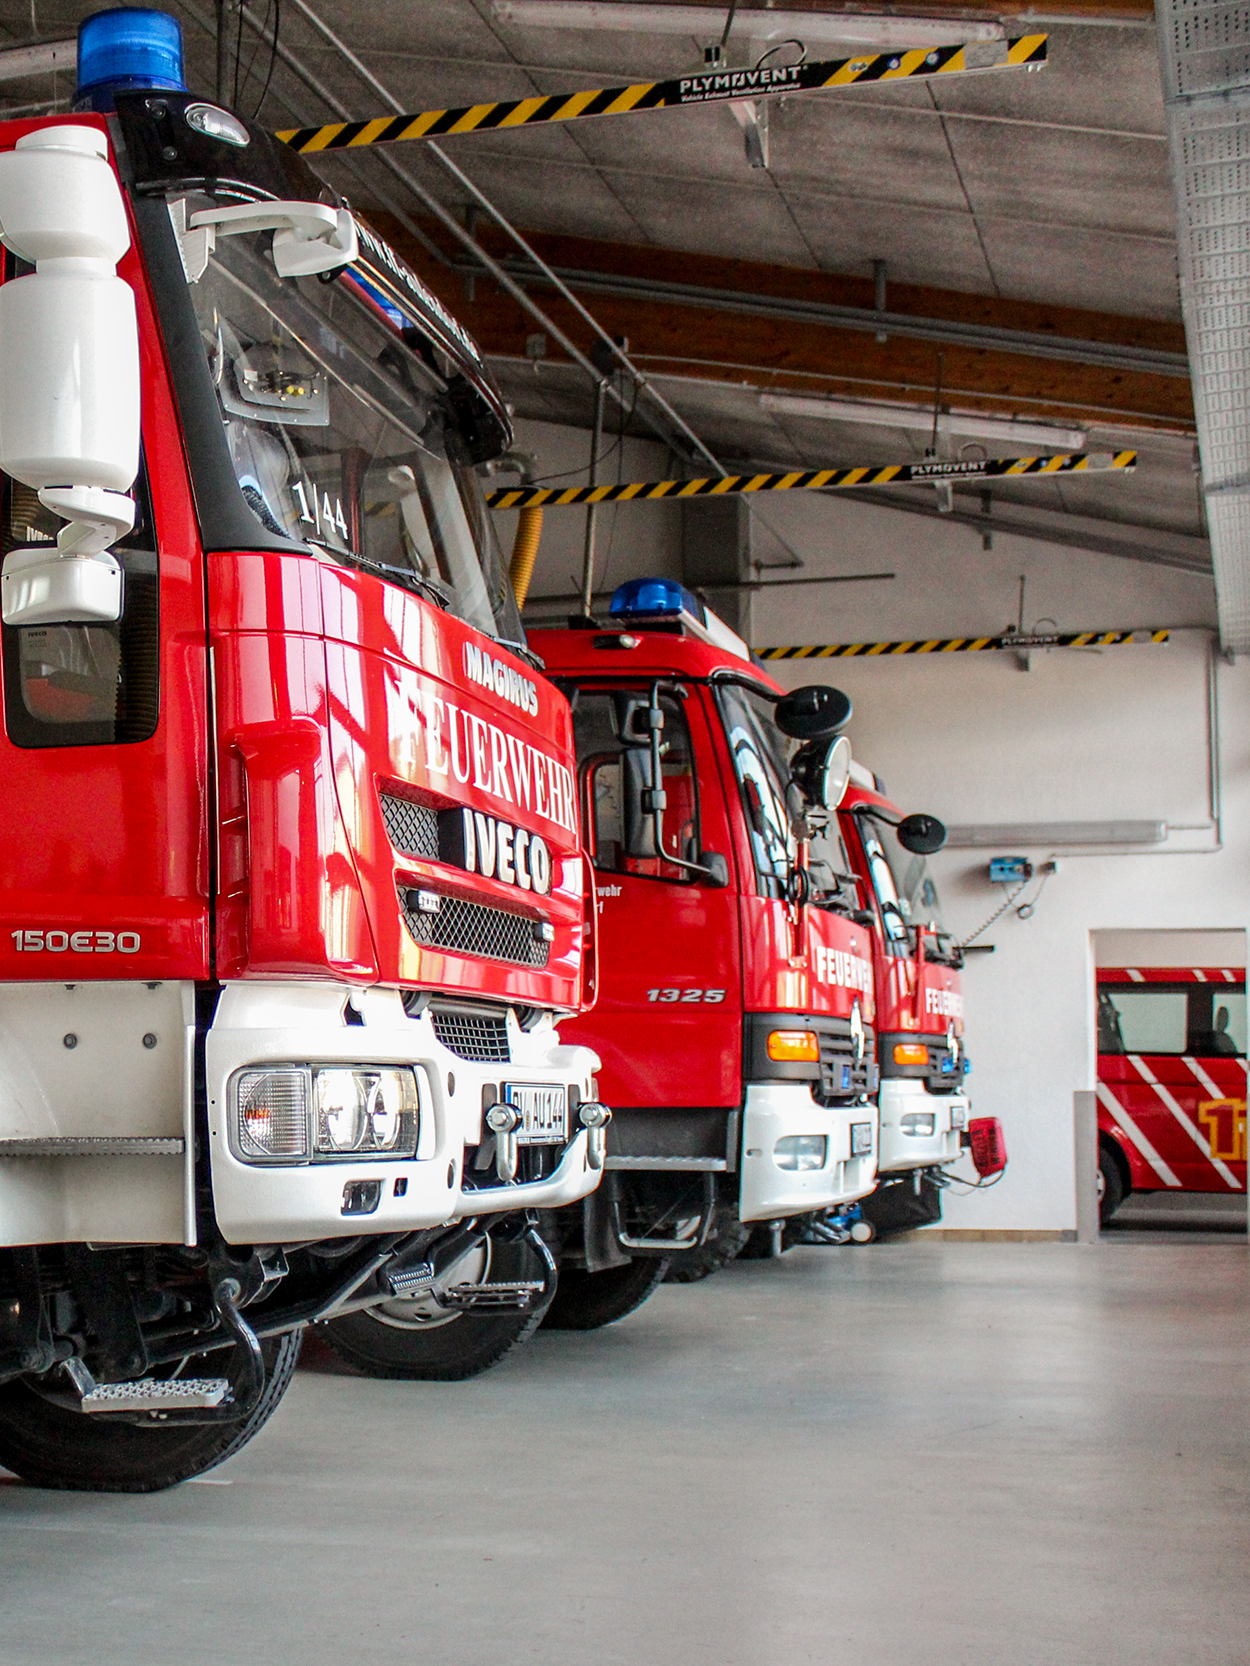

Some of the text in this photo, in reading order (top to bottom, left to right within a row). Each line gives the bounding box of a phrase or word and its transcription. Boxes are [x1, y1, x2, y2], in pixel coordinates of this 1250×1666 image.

[463, 641, 539, 717] MAGIRUS
[394, 679, 577, 835] FEUERWEHR
[462, 807, 550, 895] IVECO
[11, 930, 141, 953] 150E30
[646, 988, 728, 1003] 1325
